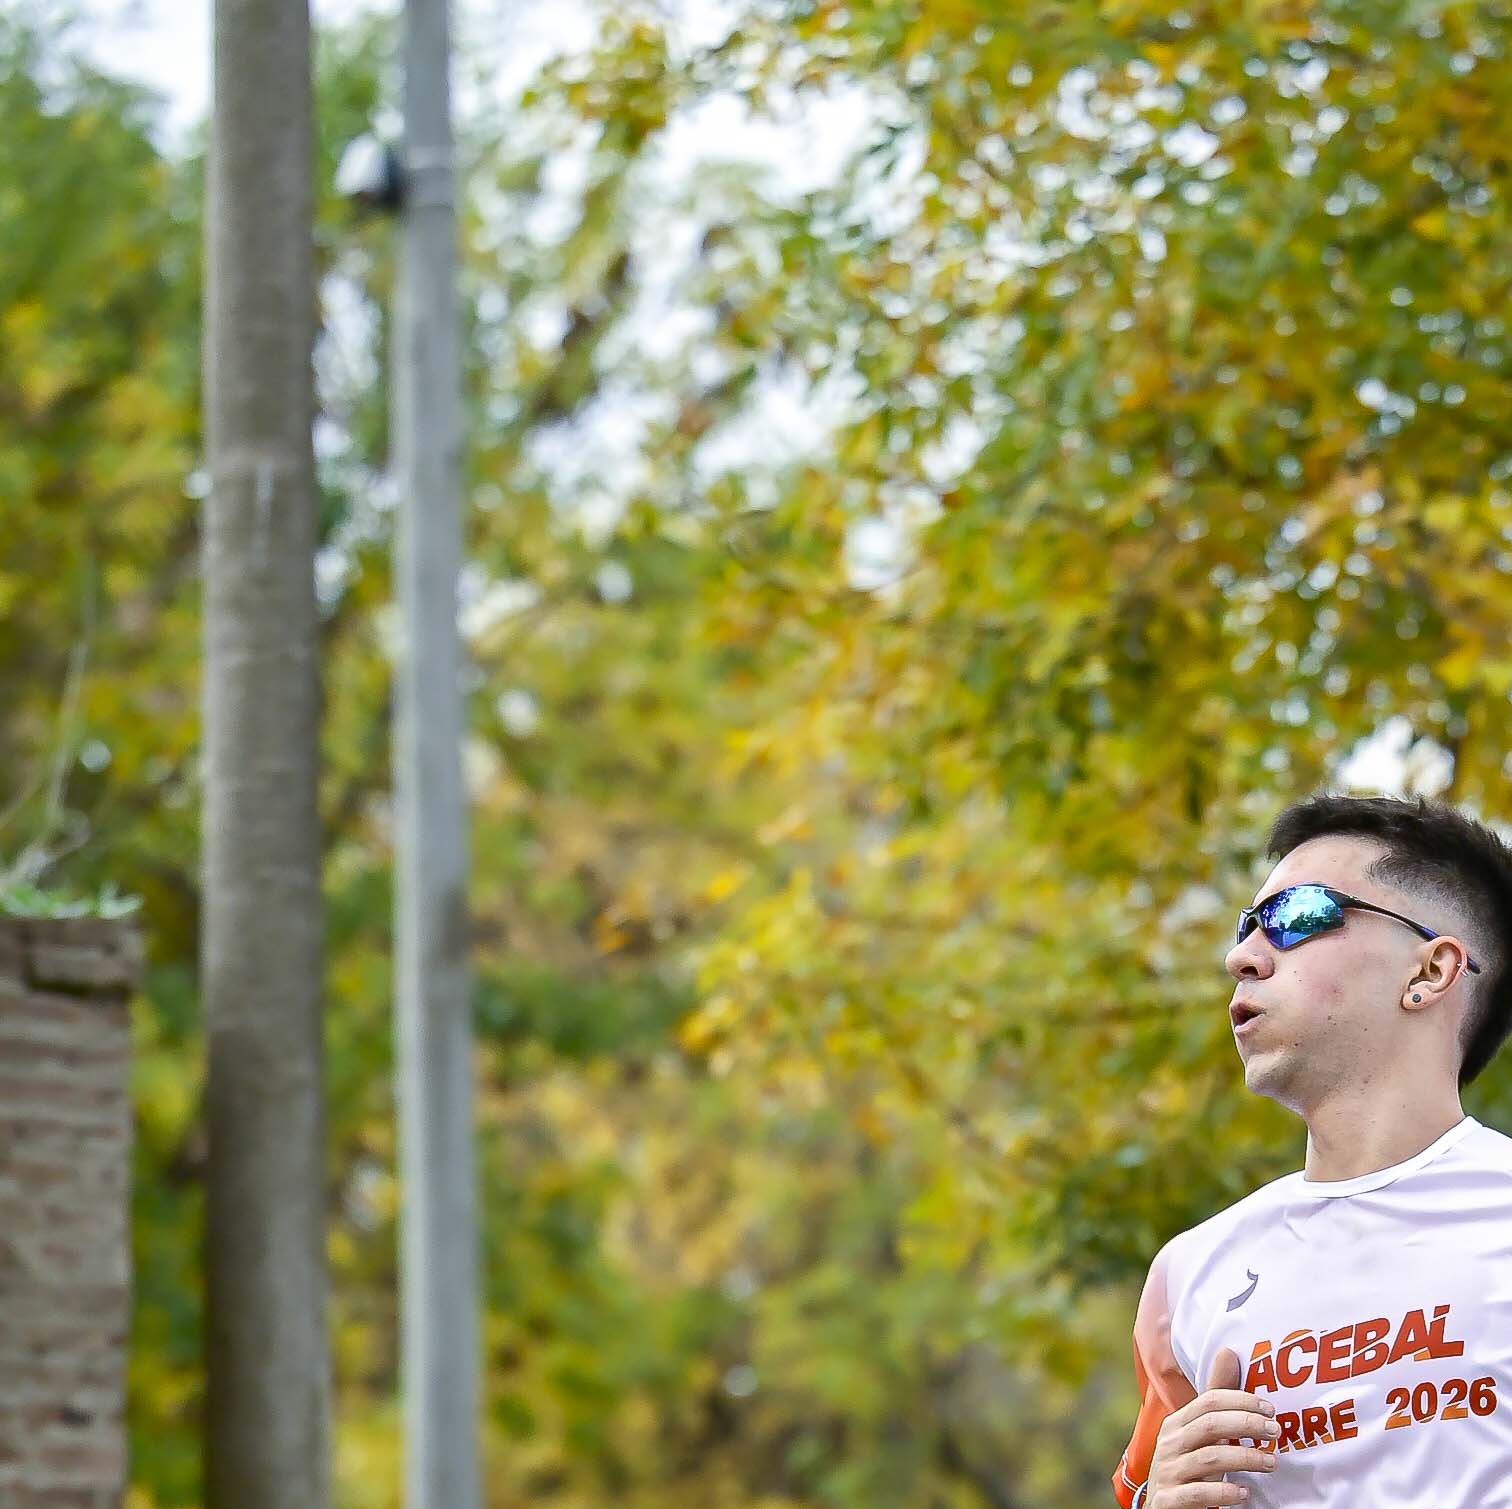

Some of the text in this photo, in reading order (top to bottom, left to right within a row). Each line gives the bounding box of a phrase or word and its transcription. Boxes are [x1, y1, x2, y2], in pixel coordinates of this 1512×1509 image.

[1244, 1304, 1464, 1394] ACEBAL
[1229, 1377, 1497, 1455] RRE 2026
